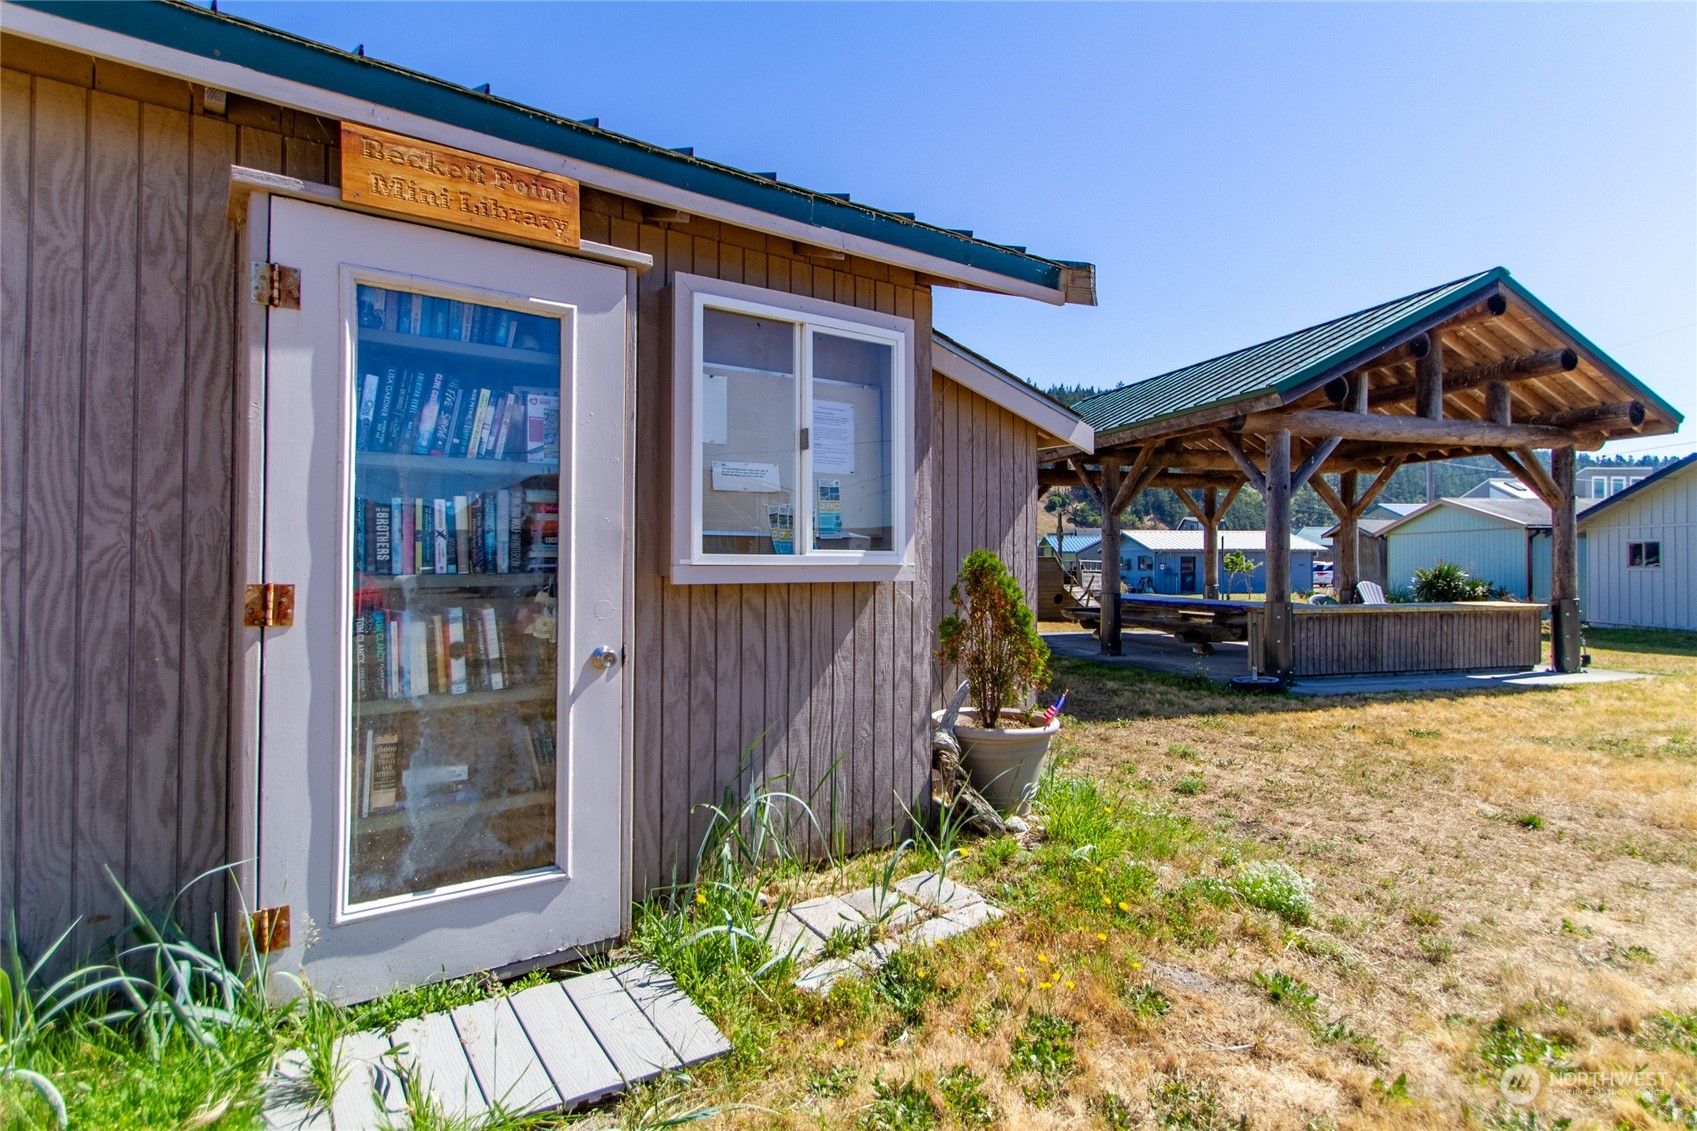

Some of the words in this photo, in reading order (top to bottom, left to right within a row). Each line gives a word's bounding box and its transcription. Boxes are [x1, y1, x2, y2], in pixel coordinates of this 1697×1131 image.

[361, 135, 486, 186] Beckett
[492, 167, 568, 205] Point
[368, 171, 452, 210] Mini
[457, 190, 569, 239] Library
[386, 368, 396, 384] LISA
[413, 371, 425, 398] AMERICAN
[432, 373, 443, 390] CLIVE
[381, 385, 393, 417] GARDNER
[444, 388, 456, 409] FIVE
[376, 512, 390, 561] BROTHERS
[511, 518, 521, 533] WOLF
[511, 540, 521, 567] PATTERSON
[356, 616, 365, 633] TOM
[357, 634, 365, 664] CLANCY
[376, 633, 385, 662] CLANCY
